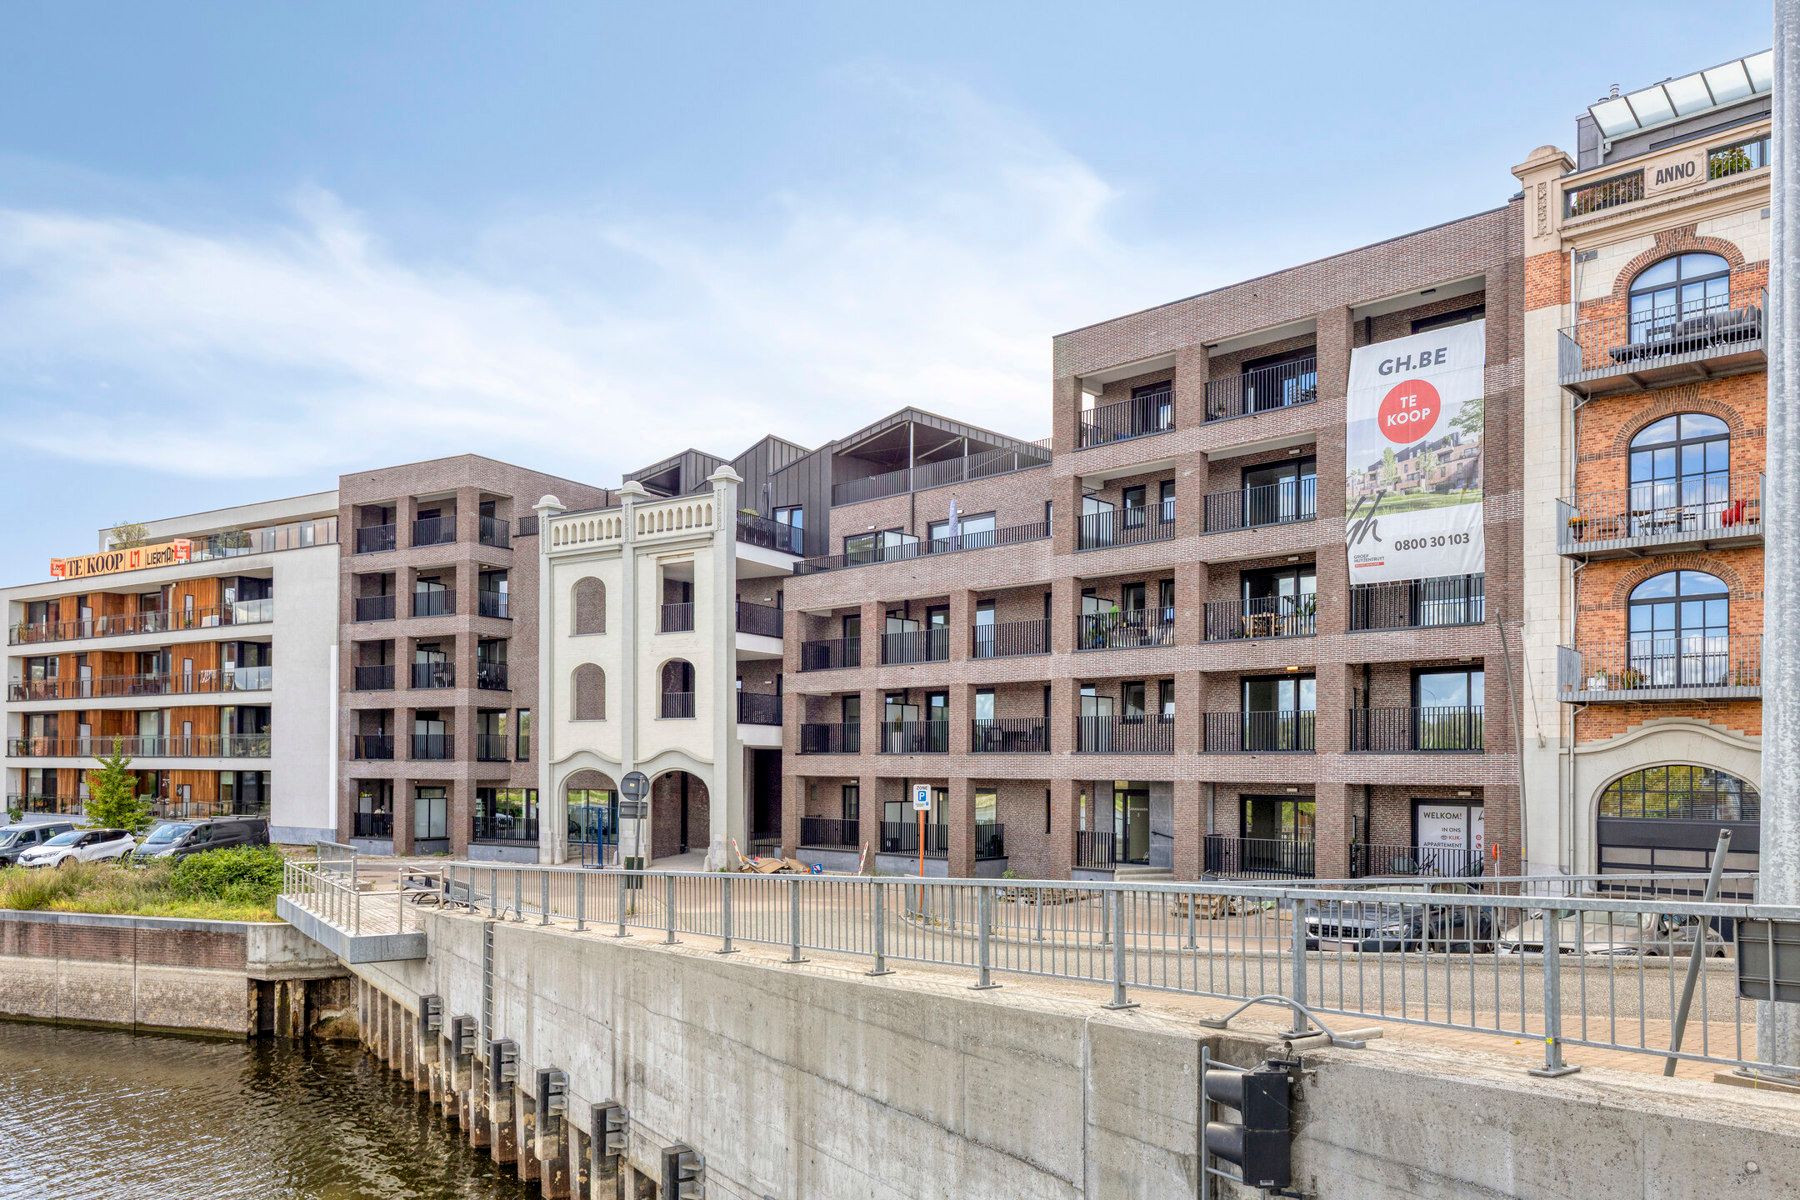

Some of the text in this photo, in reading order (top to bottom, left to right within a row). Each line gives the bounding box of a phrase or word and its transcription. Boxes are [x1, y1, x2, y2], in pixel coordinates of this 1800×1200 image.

[1655, 160, 1696, 186] ANNO
[1378, 346, 1448, 376] GH.BE
[1400, 394, 1418, 409] TE
[1387, 407, 1431, 427] KOOP
[1394, 532, 1470, 551] 0800 30 103
[67, 559, 83, 576] TE
[86, 552, 124, 573] KOOP
[146, 547, 175, 565] LIERMA
